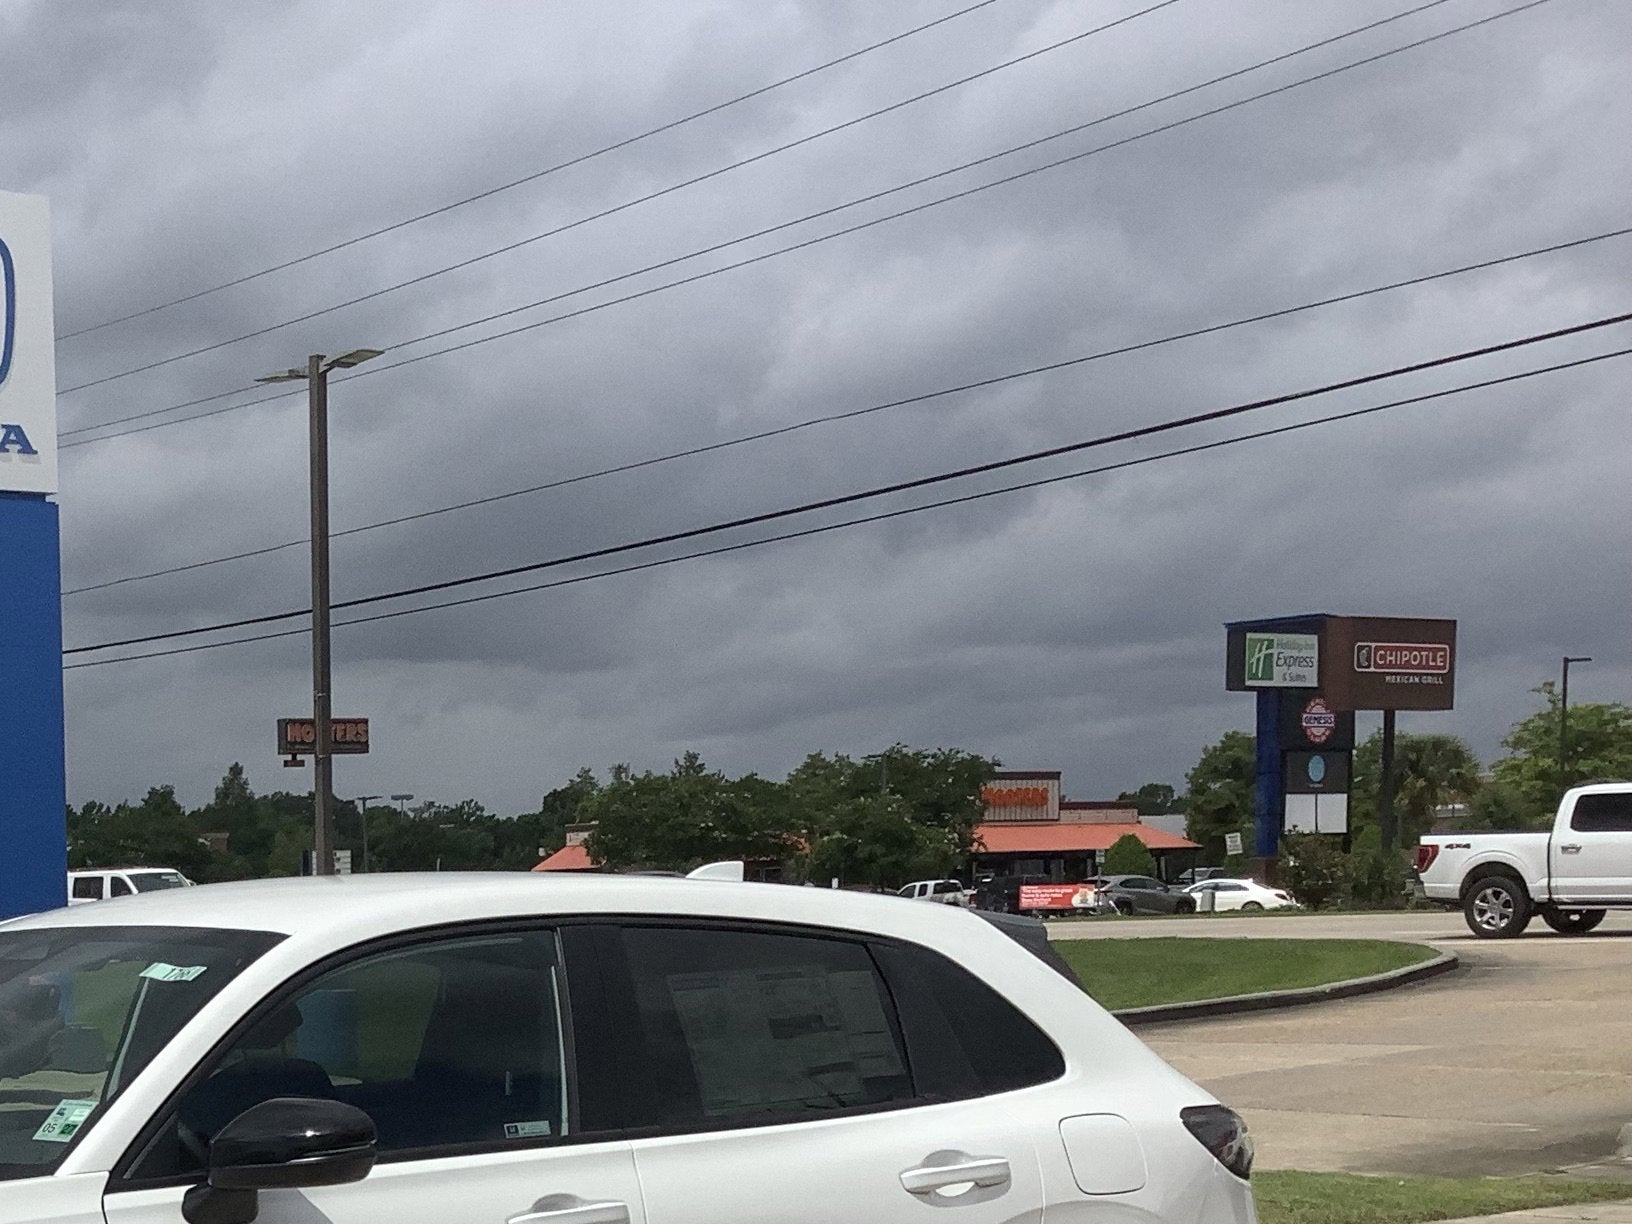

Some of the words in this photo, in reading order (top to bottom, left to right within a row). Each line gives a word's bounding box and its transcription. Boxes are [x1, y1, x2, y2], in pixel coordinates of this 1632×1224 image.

[1276, 652, 1315, 669] Express
[1376, 650, 1445, 666] CHIPOTLE
[1385, 675, 1420, 684] MEXICAN
[1422, 676, 1443, 684] GRILL
[287, 722, 369, 743] HOERS
